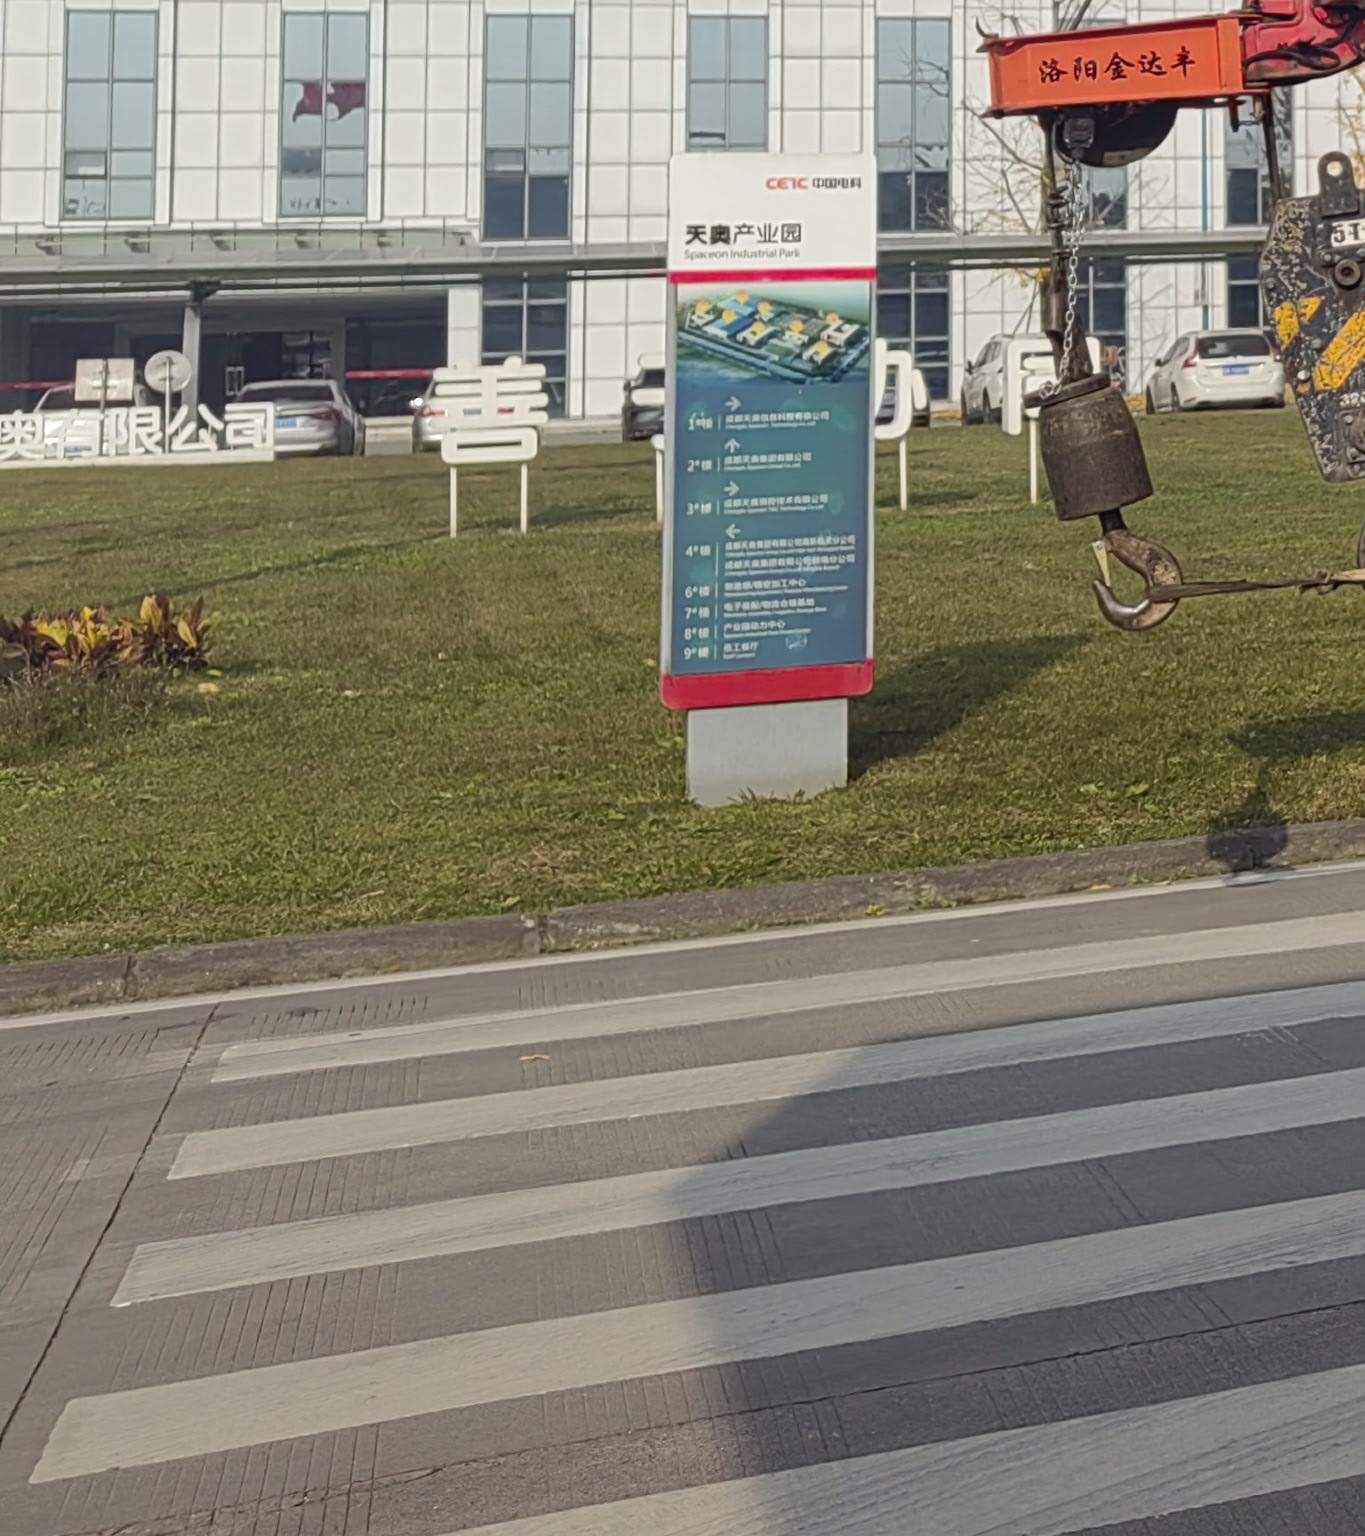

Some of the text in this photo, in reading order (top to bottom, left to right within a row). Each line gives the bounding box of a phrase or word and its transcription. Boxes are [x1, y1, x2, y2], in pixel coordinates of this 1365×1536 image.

[766, 176, 861, 190] CETC 中国电科
[685, 223, 802, 245] 天奥产业园
[684, 248, 801, 261] Spaceon Industrial Park
[0, 402, 274, 460] 奥有限公司
